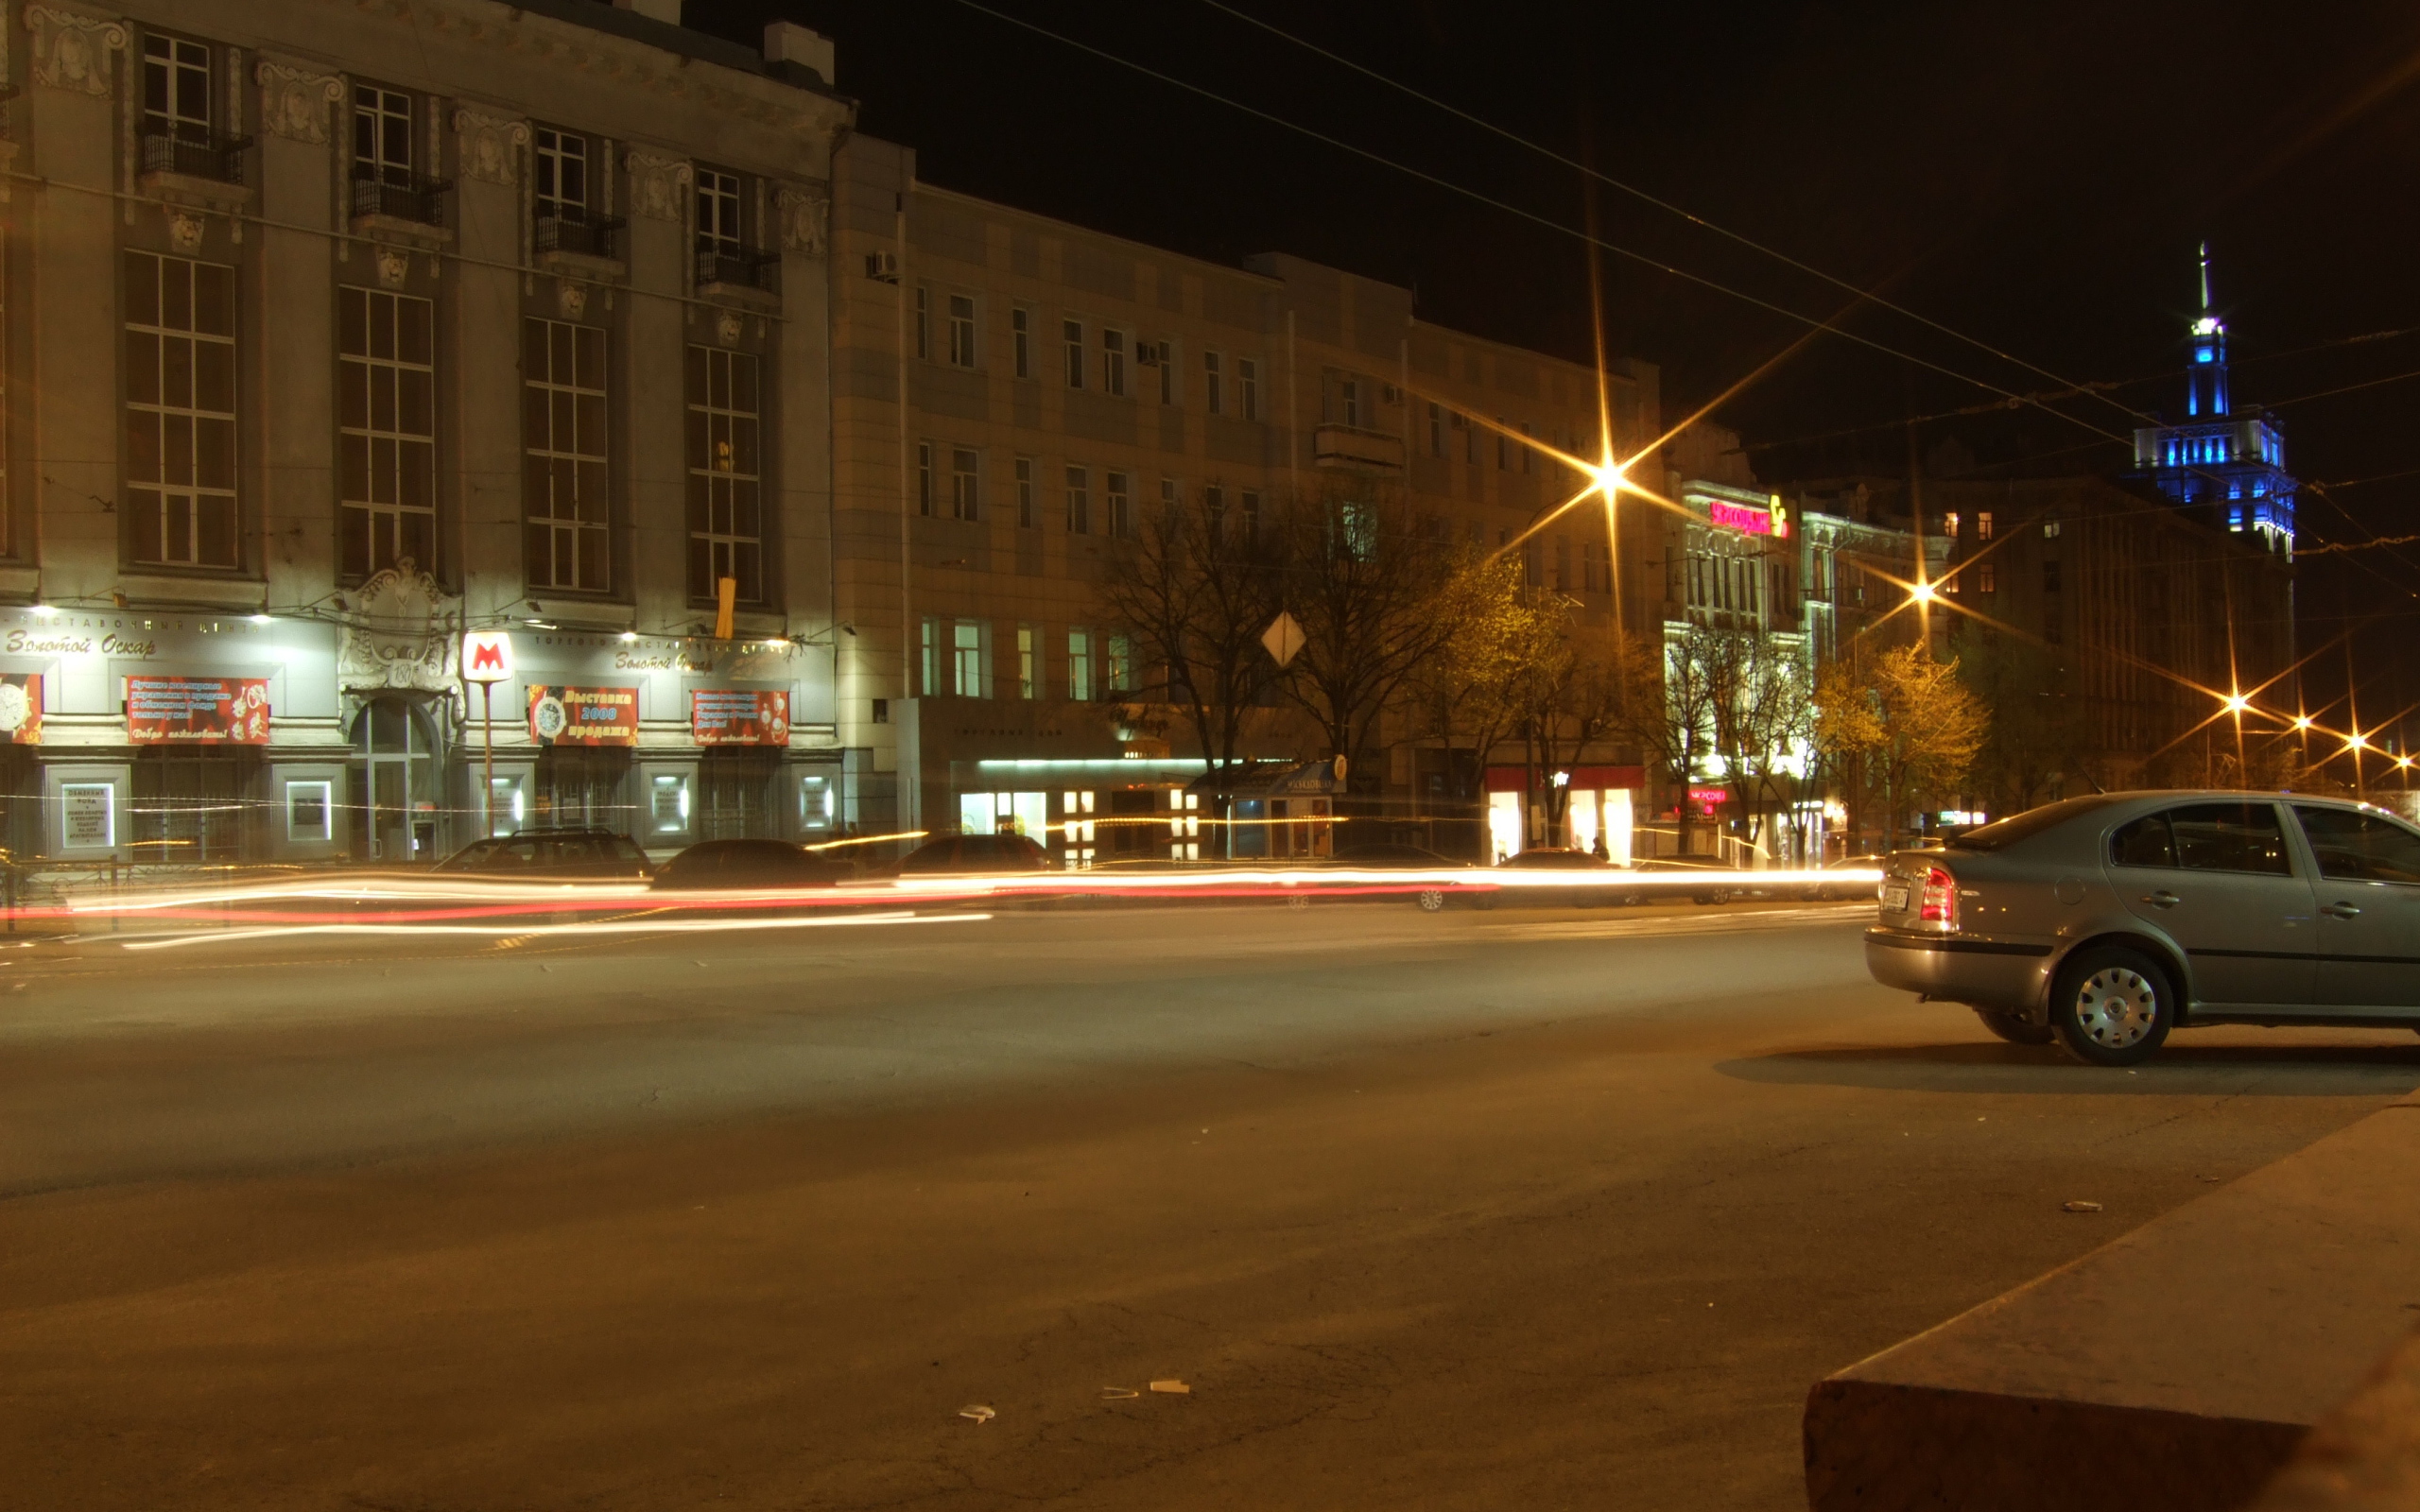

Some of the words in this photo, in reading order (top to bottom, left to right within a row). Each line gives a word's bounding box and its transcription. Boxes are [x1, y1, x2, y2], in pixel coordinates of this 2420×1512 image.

[7, 629, 93, 654] Золотой
[101, 633, 157, 661] Оскар
[472, 643, 505, 670] М
[614, 651, 672, 670] Золотой
[565, 690, 632, 705] Выставка
[581, 706, 617, 720] 2008
[132, 727, 164, 740] Добро
[568, 725, 631, 739] продажа
